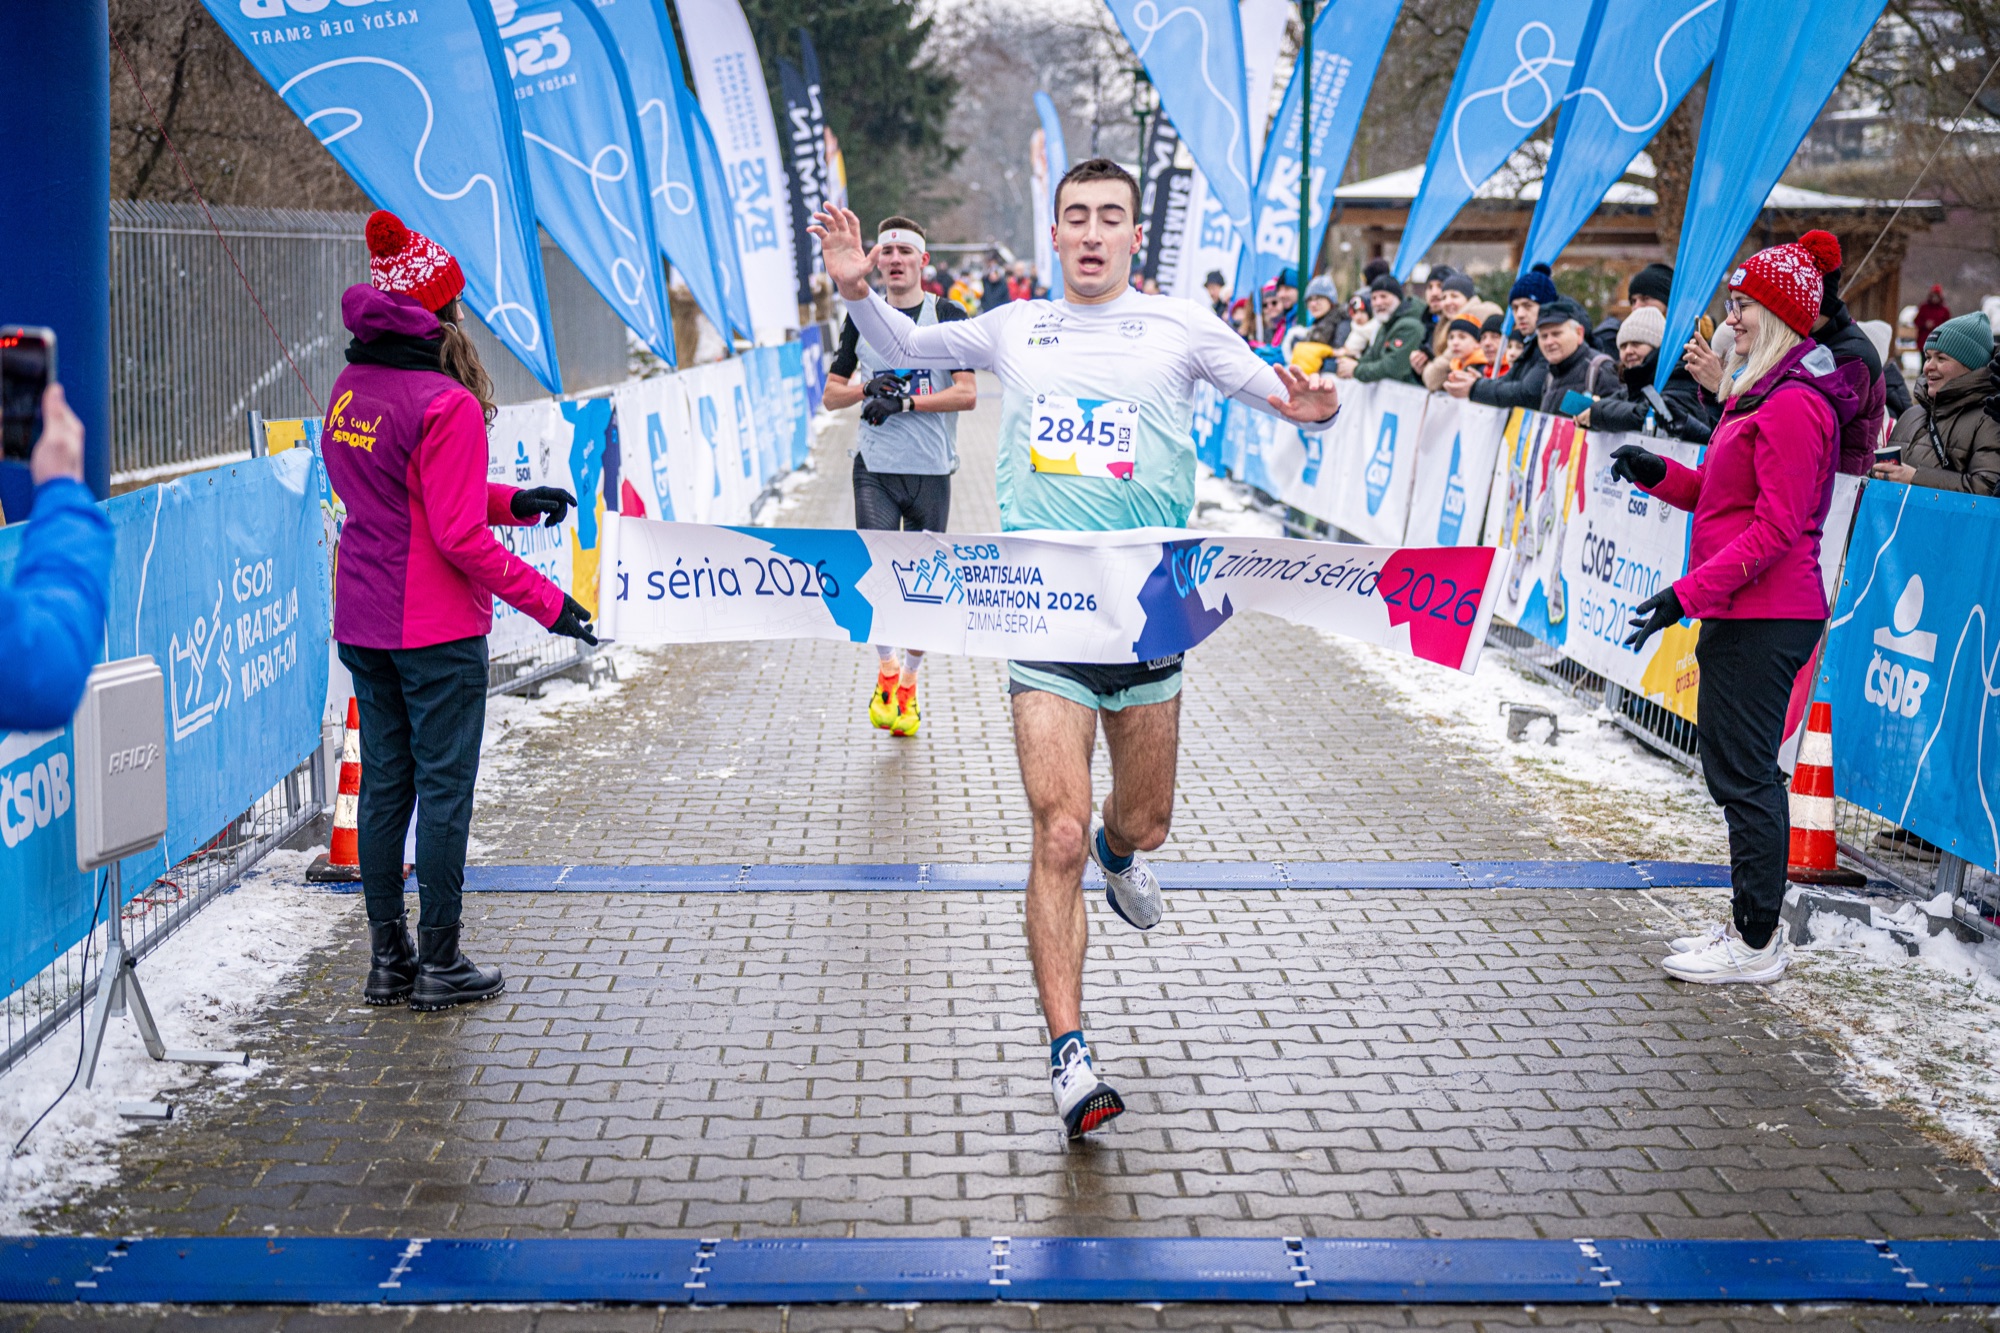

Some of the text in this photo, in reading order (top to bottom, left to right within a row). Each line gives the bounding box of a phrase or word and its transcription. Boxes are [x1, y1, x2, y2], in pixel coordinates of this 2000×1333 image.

[332, 429, 377, 453] SPORT
[1037, 416, 1115, 447] 2845
[952, 543, 1000, 561] ČSOB
[1581, 520, 1616, 583] ČSOB
[232, 557, 273, 604] ČSOB
[647, 556, 742, 601] séria
[744, 557, 840, 599] 2026
[962, 565, 1044, 586] BRATISLAVA
[1214, 549, 1316, 581] zimná
[1304, 557, 1384, 598] séria
[1384, 567, 1481, 627] 2026
[967, 588, 1097, 612] MARATHON 2026
[967, 610, 1049, 634] ZIMNÁ SÉRIA
[1604, 597, 1644, 655] 202
[1864, 648, 1930, 719] ČSOB
[0, 770, 71, 849] ČSOB
